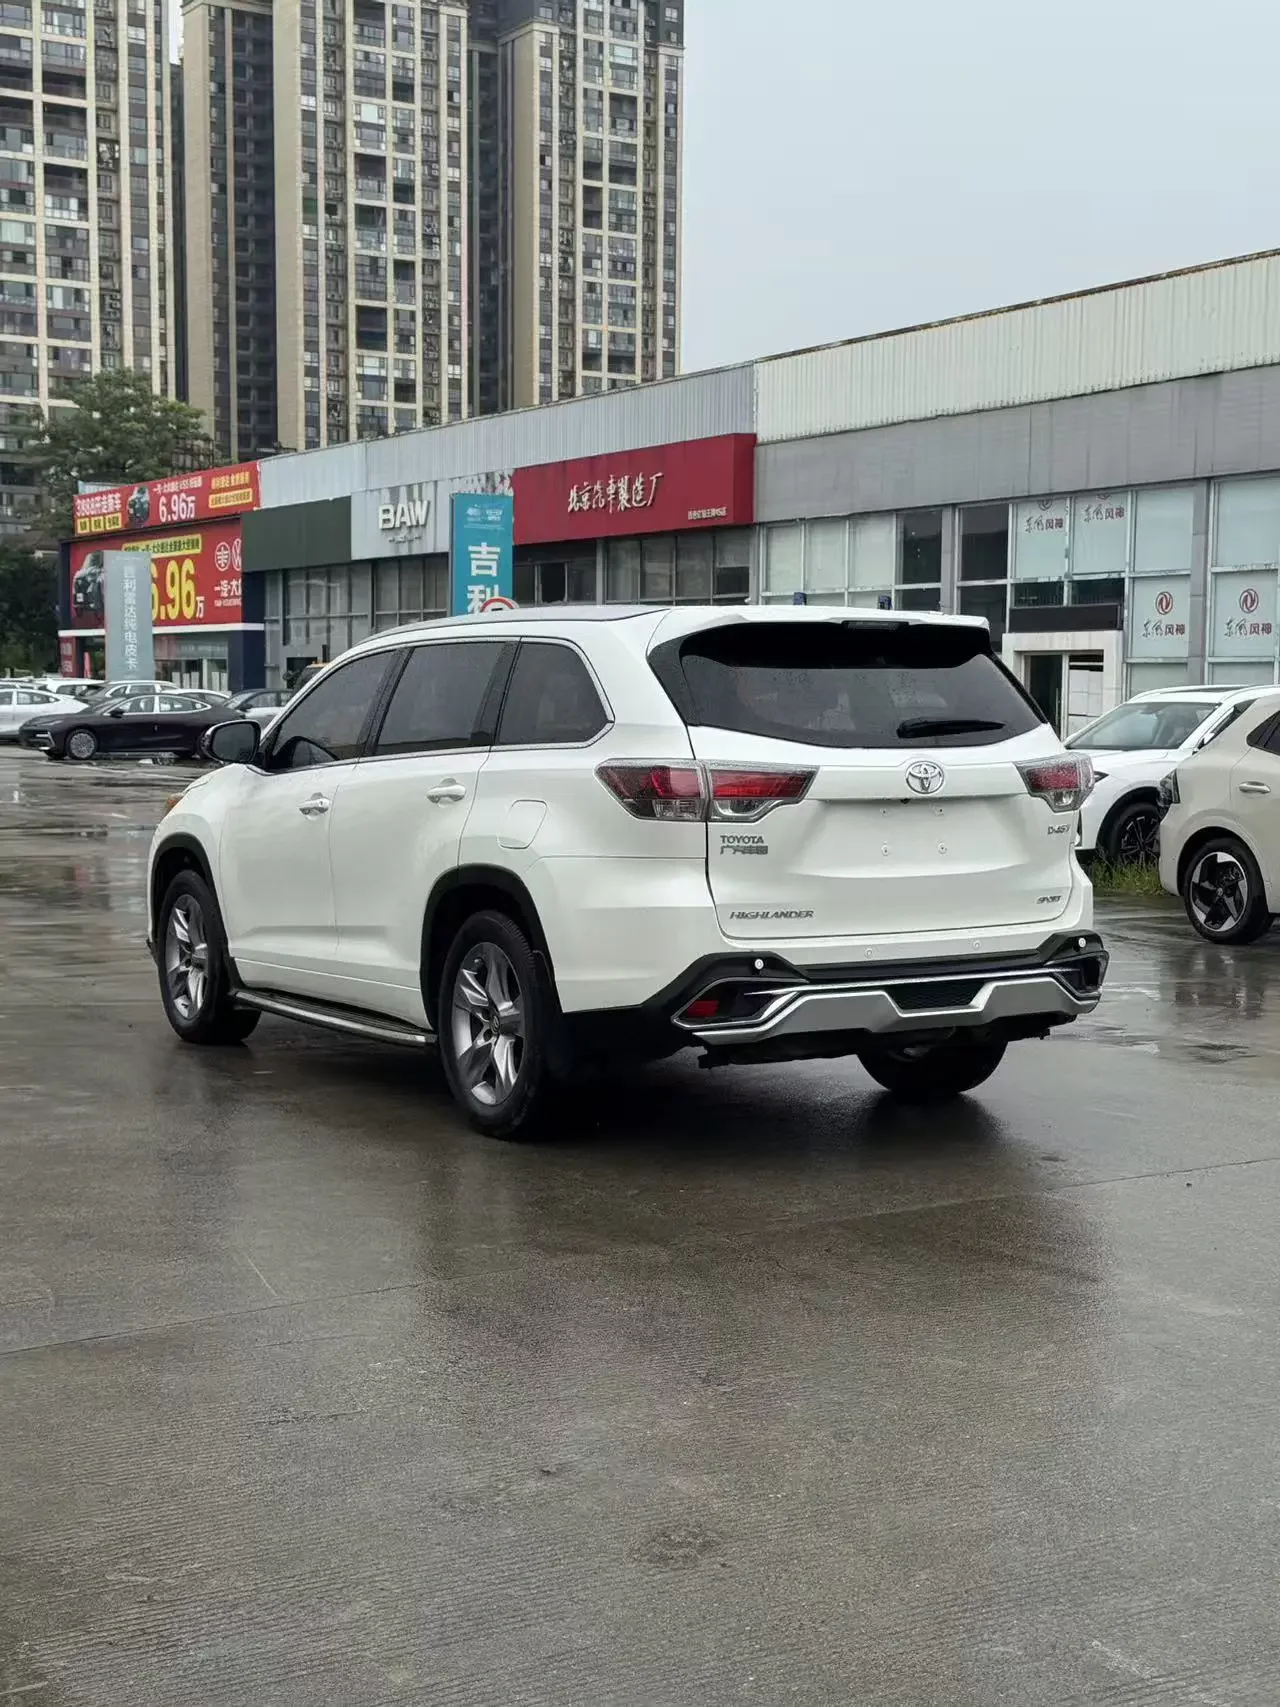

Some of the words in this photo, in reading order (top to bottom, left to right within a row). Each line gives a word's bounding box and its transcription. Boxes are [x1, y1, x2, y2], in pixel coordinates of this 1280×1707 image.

[159, 492, 196, 523] 6.96万
[378, 499, 430, 530] BAW
[1142, 618, 1186, 638] 东风风神
[1224, 616, 1272, 637] 东风风神
[720, 834, 765, 844] TOYOTA
[729, 910, 815, 920] HIGHLANDER
